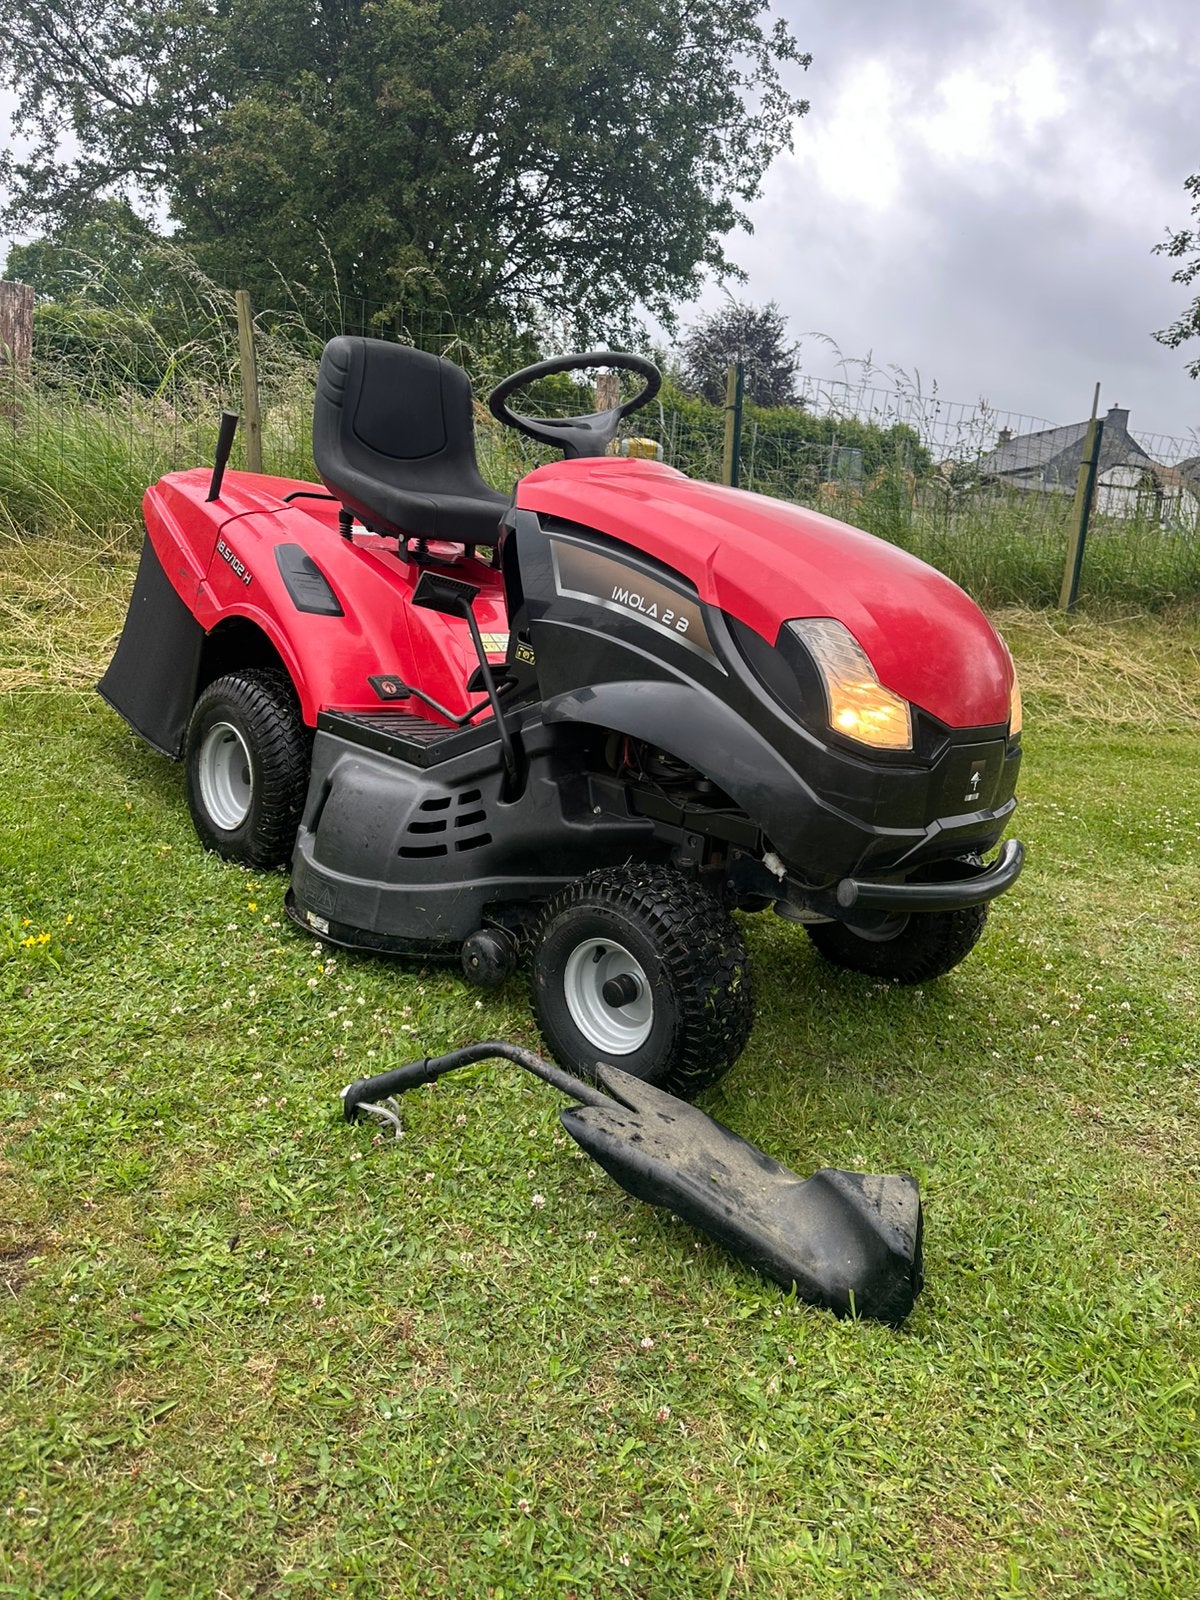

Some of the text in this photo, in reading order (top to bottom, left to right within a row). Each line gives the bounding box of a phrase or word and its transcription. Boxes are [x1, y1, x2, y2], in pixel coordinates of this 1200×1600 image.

[242, 571, 252, 585] H
[611, 585, 658, 619] IMOLA
[661, 608, 675, 625] 2
